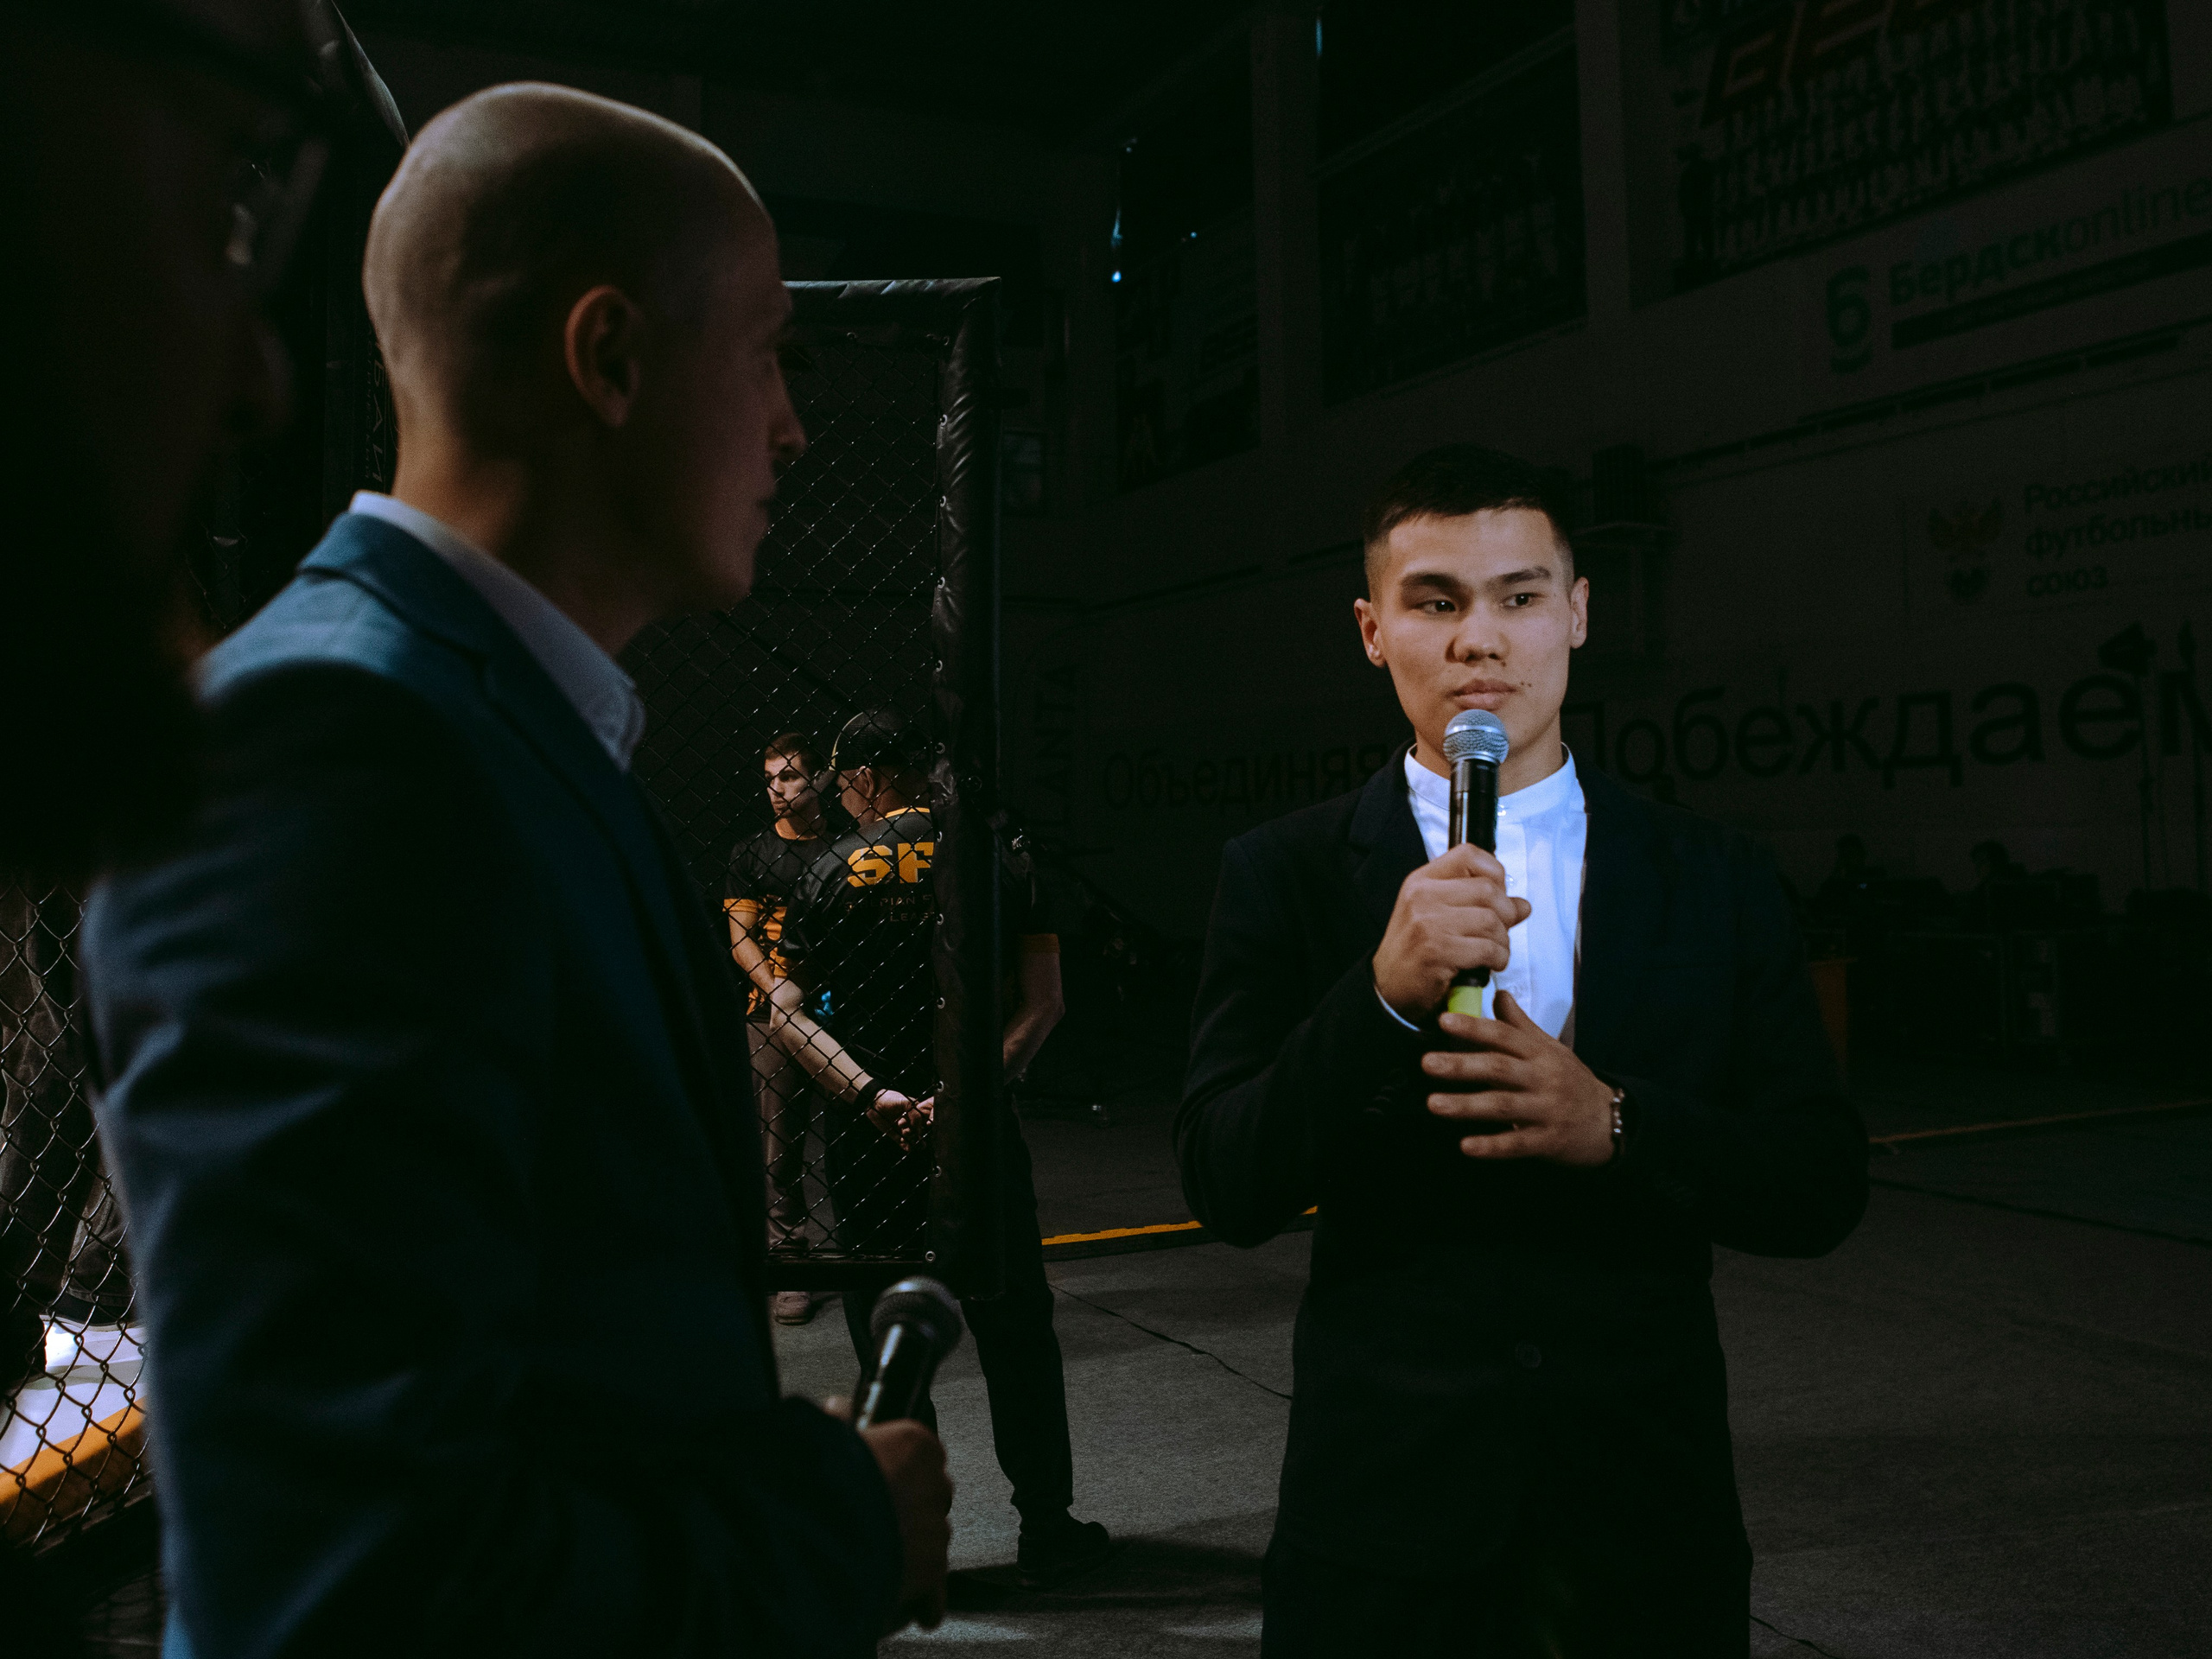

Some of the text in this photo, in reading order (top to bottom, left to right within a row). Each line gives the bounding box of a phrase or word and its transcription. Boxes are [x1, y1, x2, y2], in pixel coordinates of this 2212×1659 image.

[2025, 564, 2108, 597] союз
[1032, 663, 1077, 826] LANTA
[847, 842, 934, 887] SF
